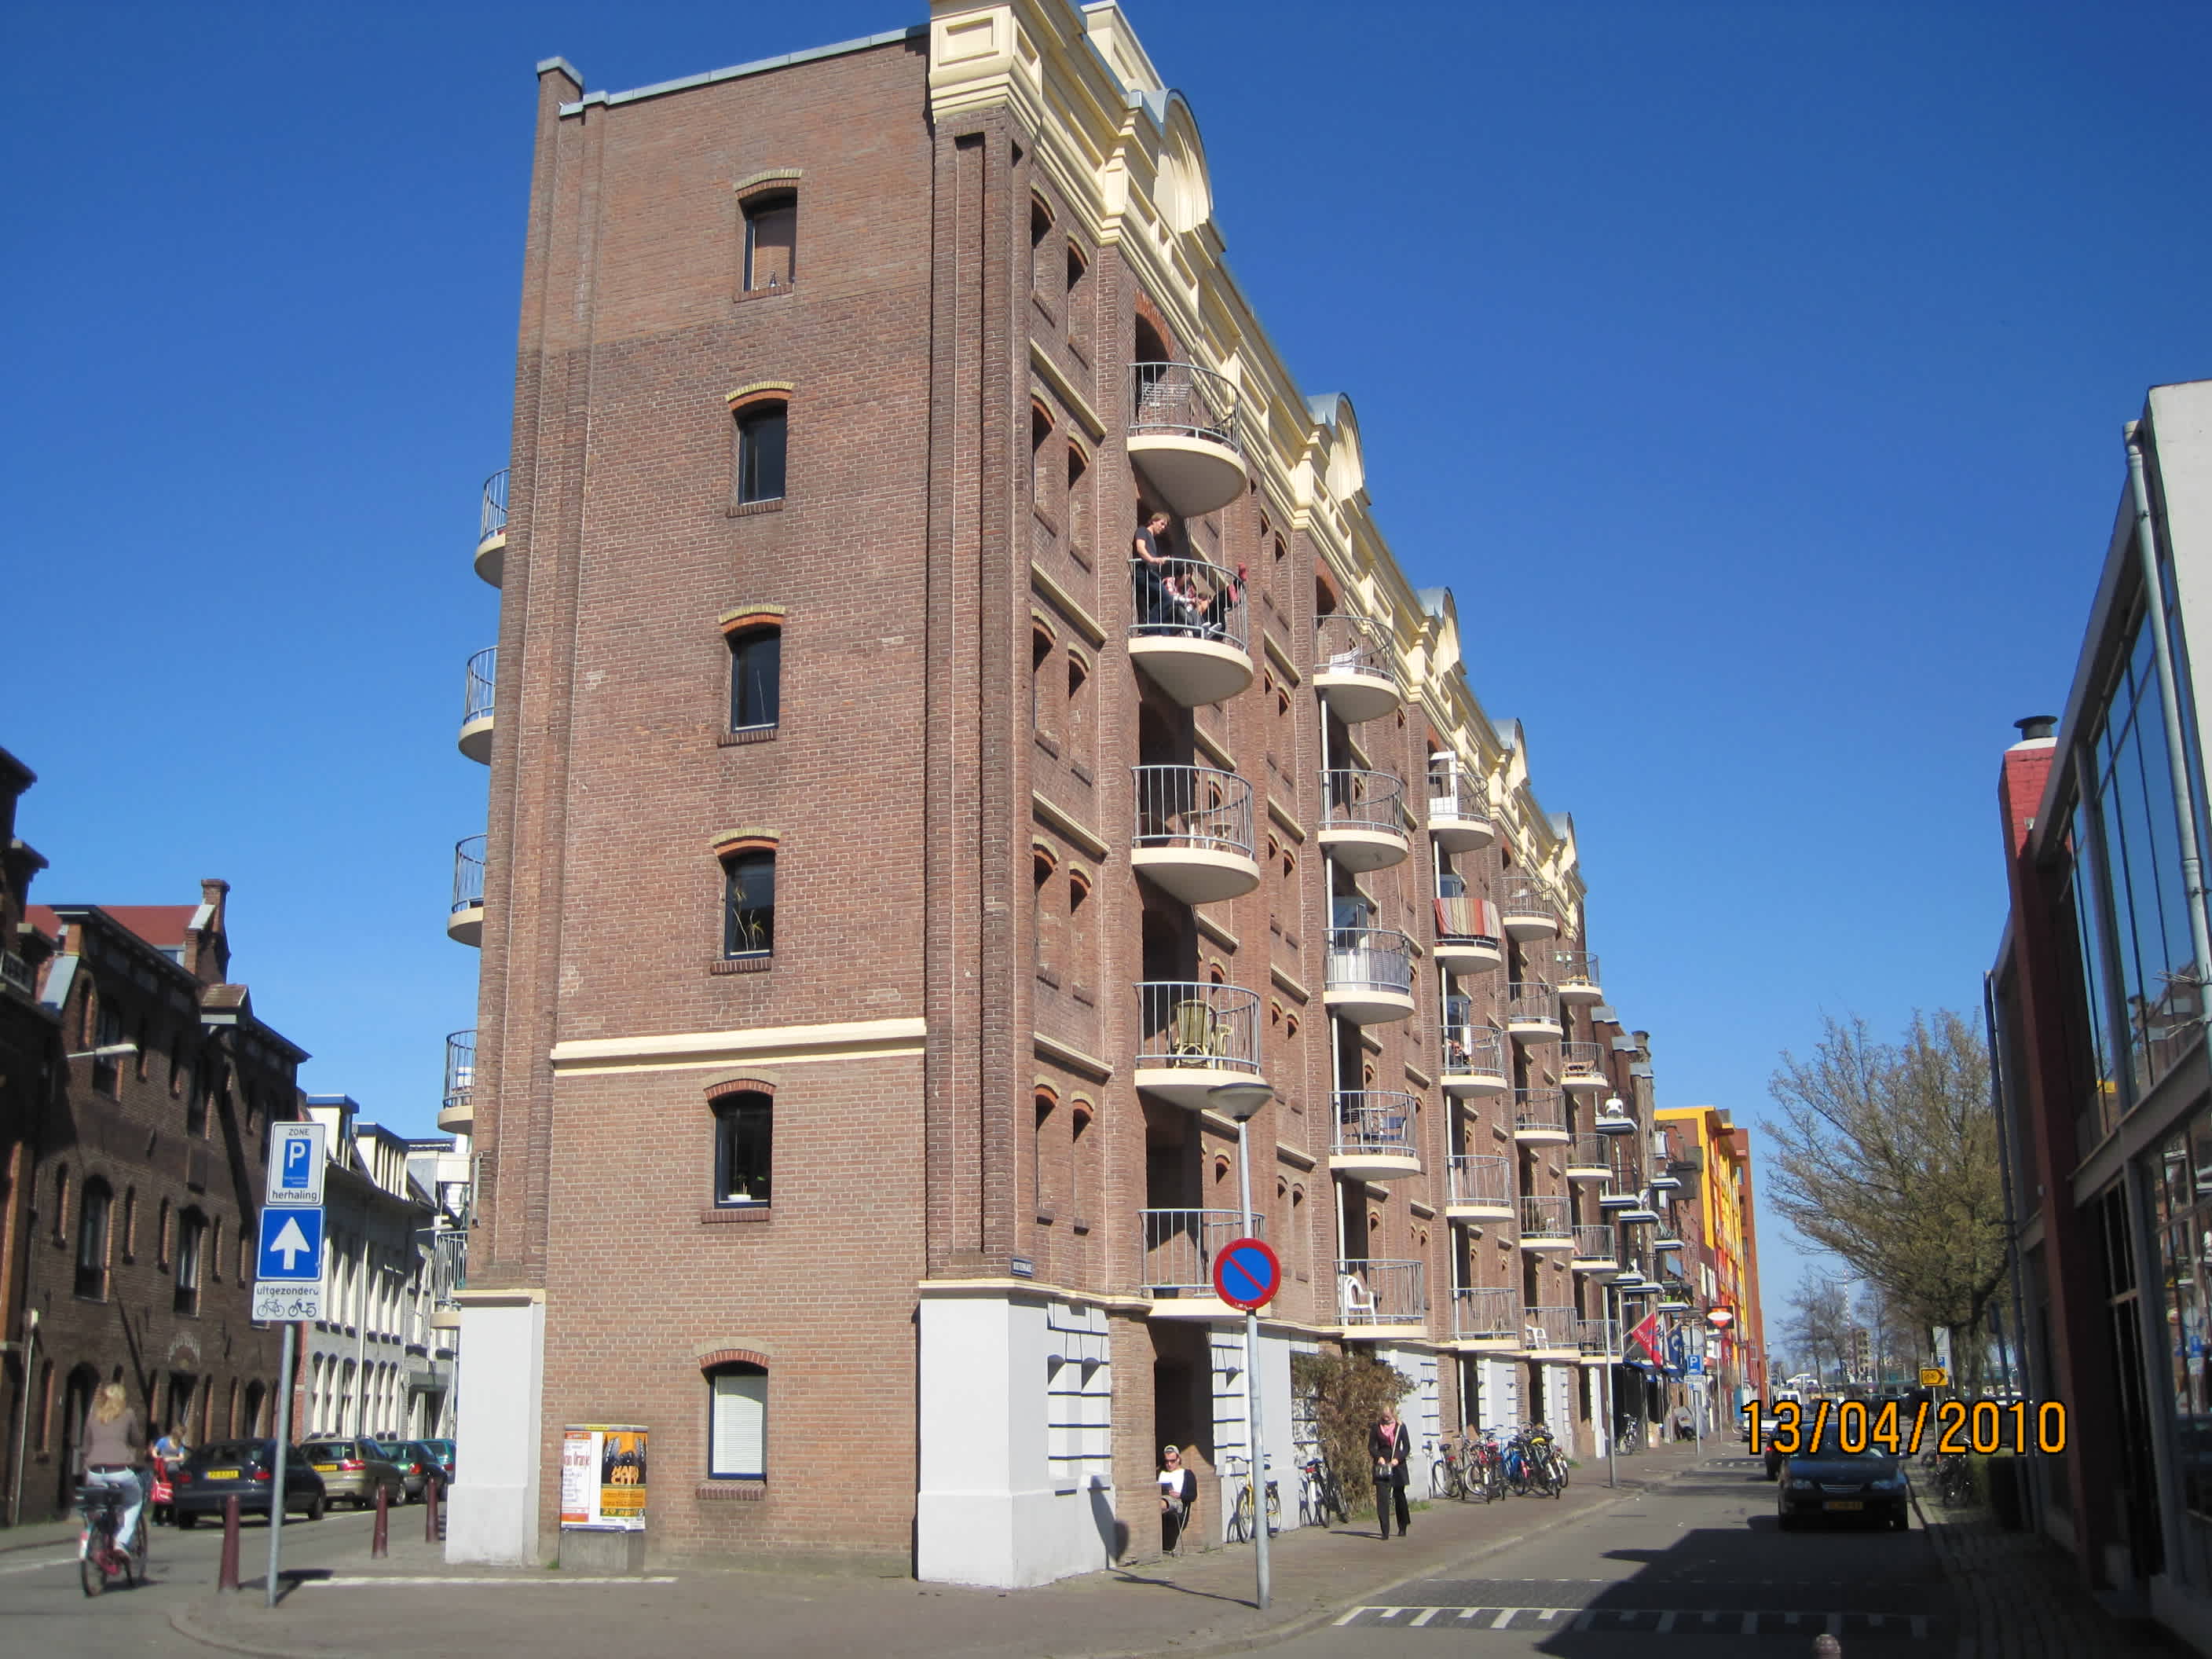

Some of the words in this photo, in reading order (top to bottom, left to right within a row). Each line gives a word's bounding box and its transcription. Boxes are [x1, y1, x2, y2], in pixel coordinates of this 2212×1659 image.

[288, 1128, 310, 1137] ZONE
[288, 1141, 306, 1169] P
[272, 1189, 317, 1202] herhaling
[610, 1475, 639, 1485] CITY
